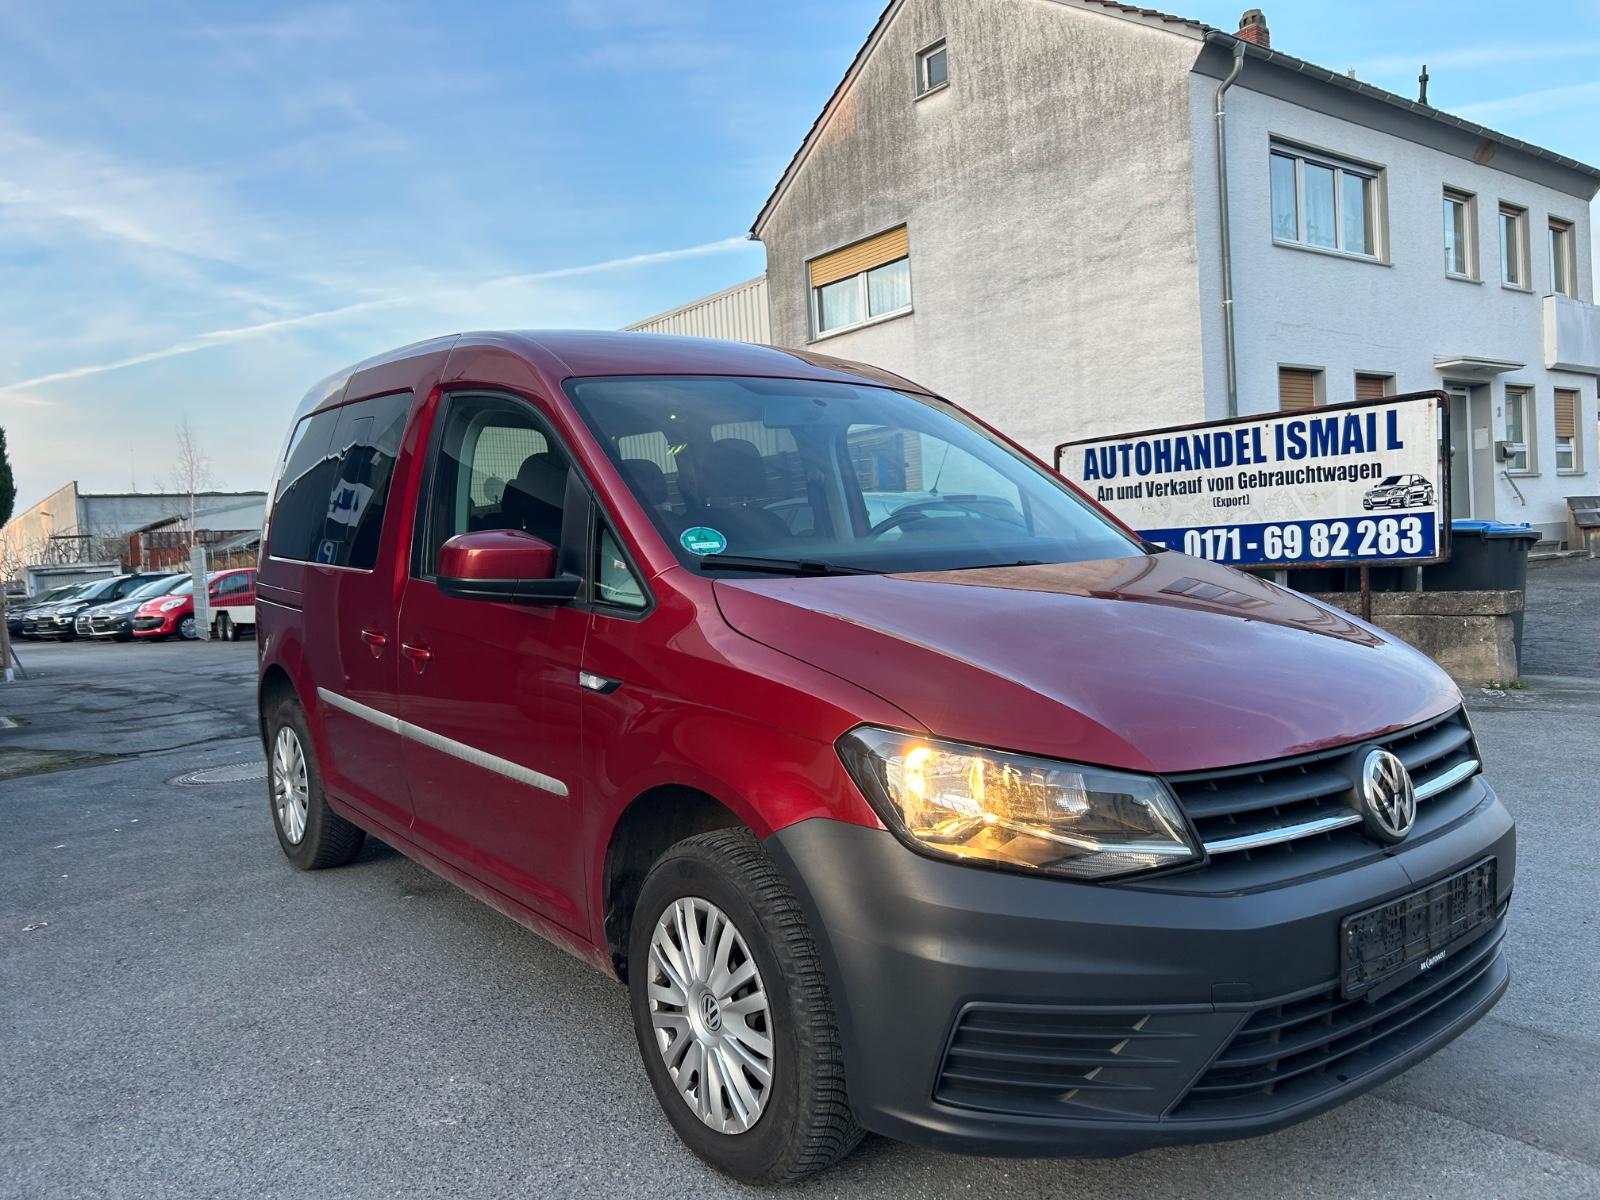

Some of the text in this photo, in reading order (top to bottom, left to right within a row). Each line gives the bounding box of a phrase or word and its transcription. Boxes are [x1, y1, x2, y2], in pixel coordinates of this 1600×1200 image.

[1083, 426, 1267, 481] AUTOHANDEL
[1097, 462, 1382, 502] An und Verkauf von Gebrauchtwagen
[1184, 527, 1241, 561] 0171
[1263, 524, 1303, 560] 69
[1309, 521, 1350, 558] 82
[1356, 516, 1423, 555] 283
[1363, 749, 1417, 838] VW
